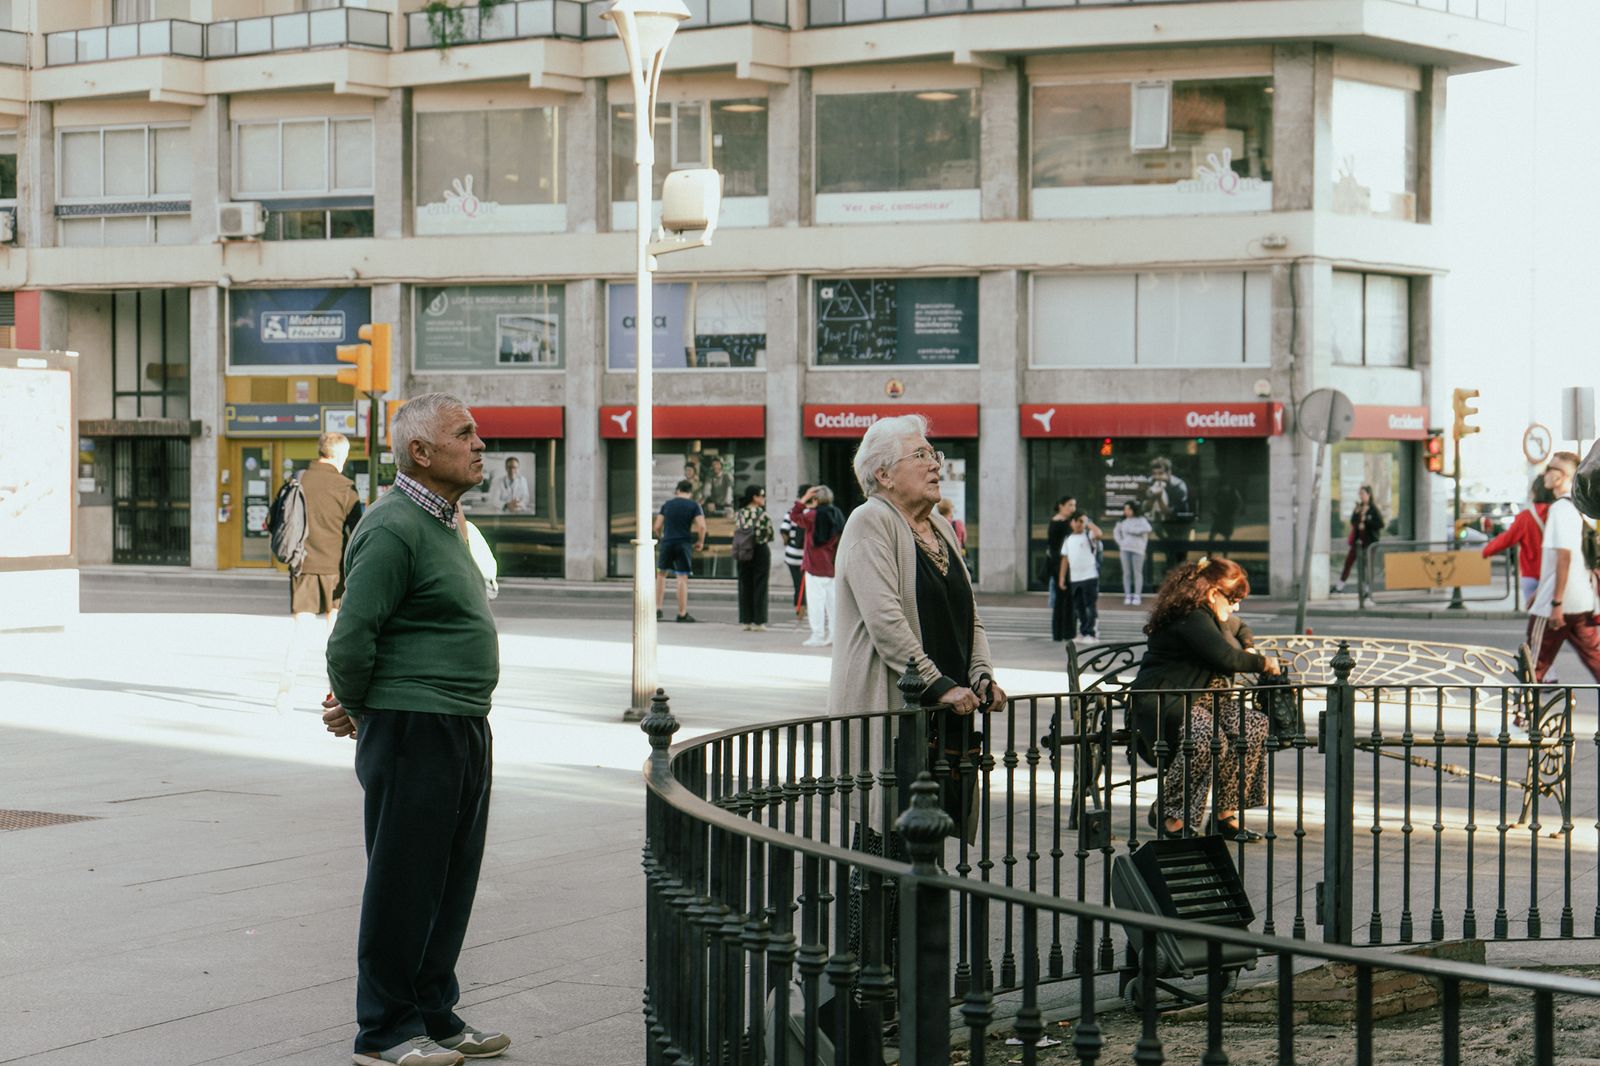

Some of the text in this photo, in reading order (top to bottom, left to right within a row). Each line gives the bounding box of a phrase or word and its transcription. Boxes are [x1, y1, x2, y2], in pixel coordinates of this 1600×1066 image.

[289, 314, 343, 325] Mudanzas
[815, 413, 878, 428] Occident
[1186, 411, 1256, 428] Occident
[1388, 414, 1424, 430] Occident
